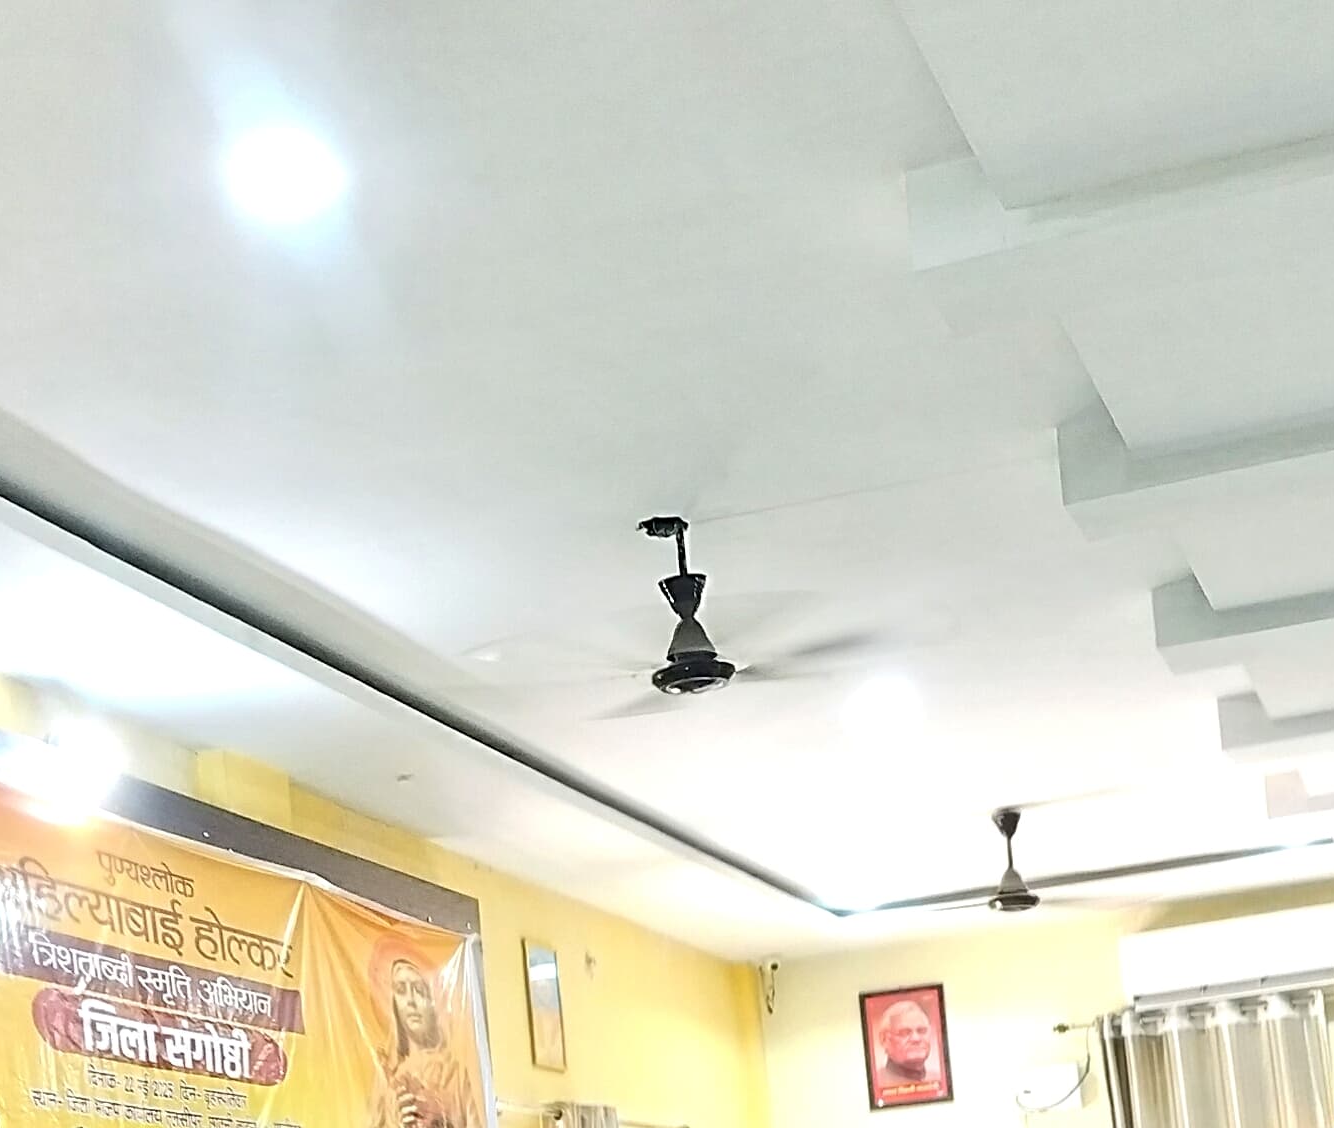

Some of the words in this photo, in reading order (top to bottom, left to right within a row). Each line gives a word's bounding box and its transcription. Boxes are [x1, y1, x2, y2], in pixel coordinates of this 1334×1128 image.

[96, 850, 195, 898] पुण्यश्लोक
[189, 906, 294, 978] होल्कर
[135, 964, 192, 1006] स्मृति
[197, 976, 272, 1018] अभियान
[78, 998, 159, 1063] जिला
[159, 1020, 252, 1079] संगोष्ठी
